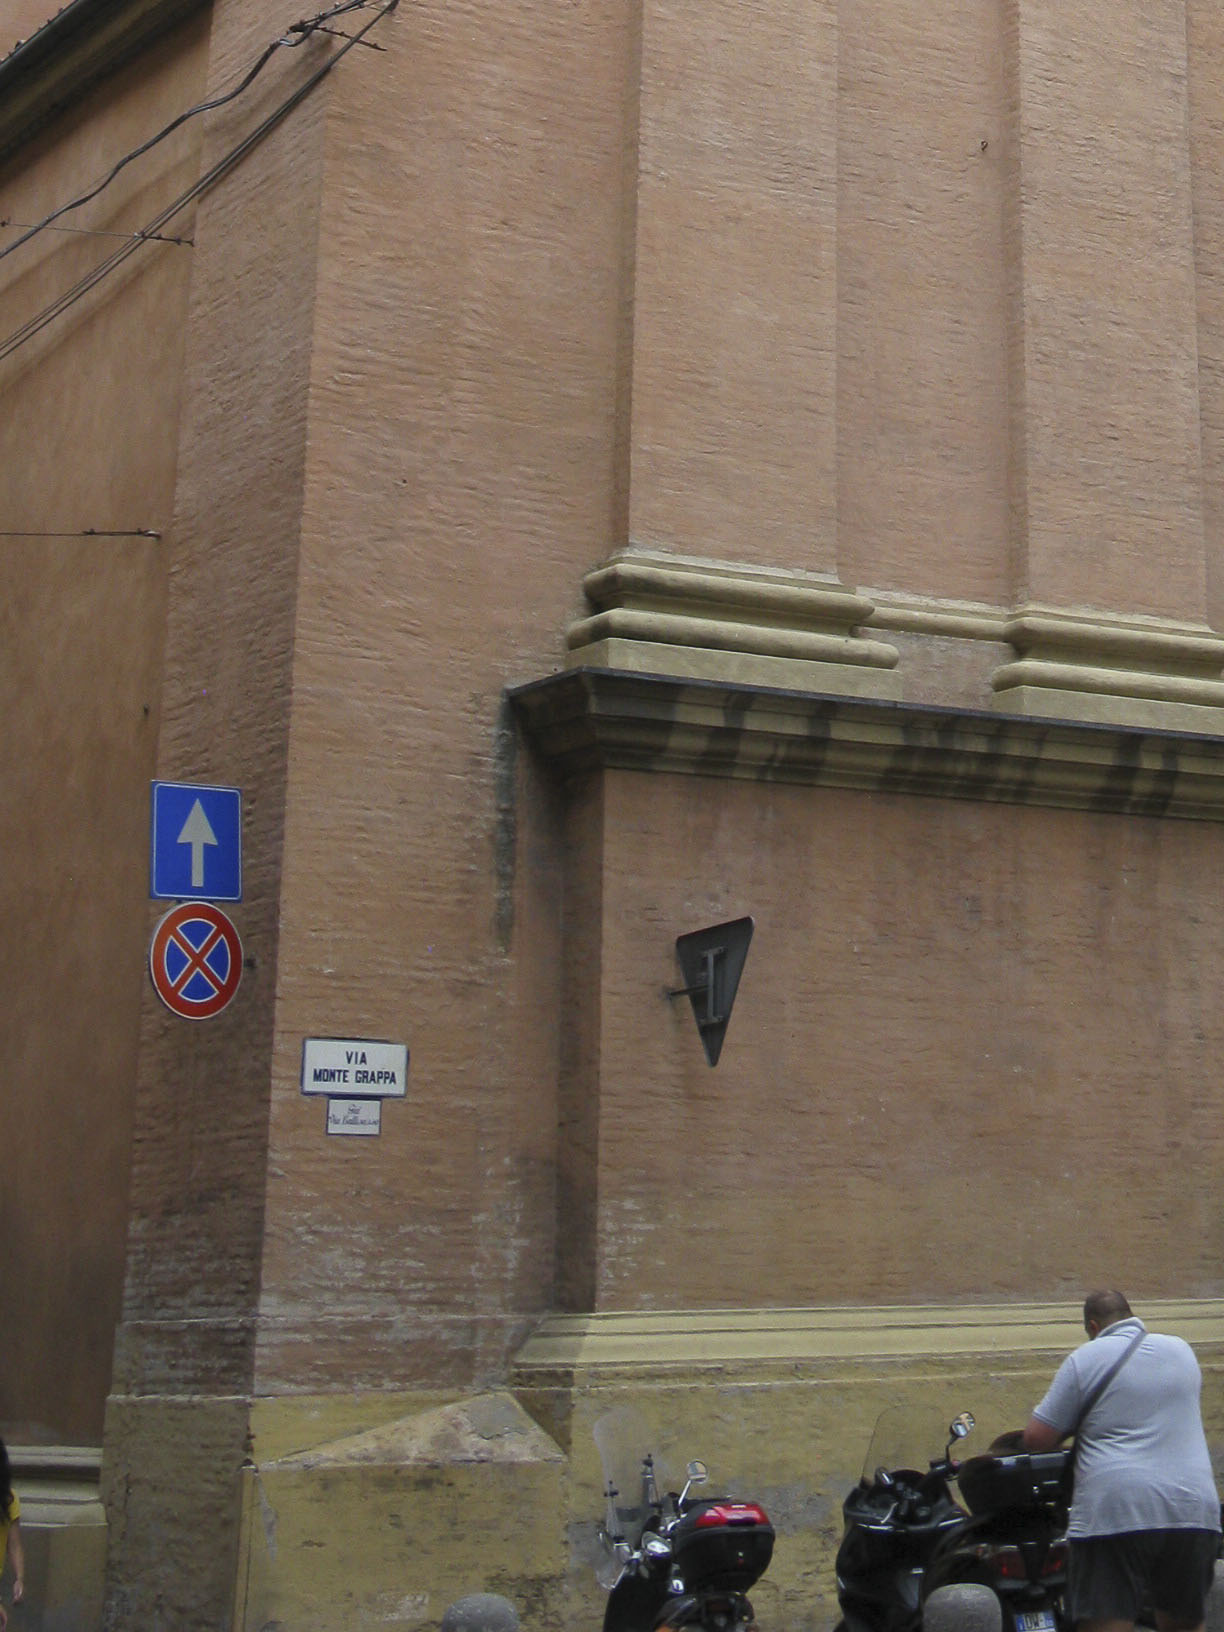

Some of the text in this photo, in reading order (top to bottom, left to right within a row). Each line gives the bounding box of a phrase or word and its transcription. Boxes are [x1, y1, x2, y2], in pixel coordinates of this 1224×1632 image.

[345, 1050, 367, 1065] VIA
[313, 1068, 397, 1084] MONTE GRAPPA
